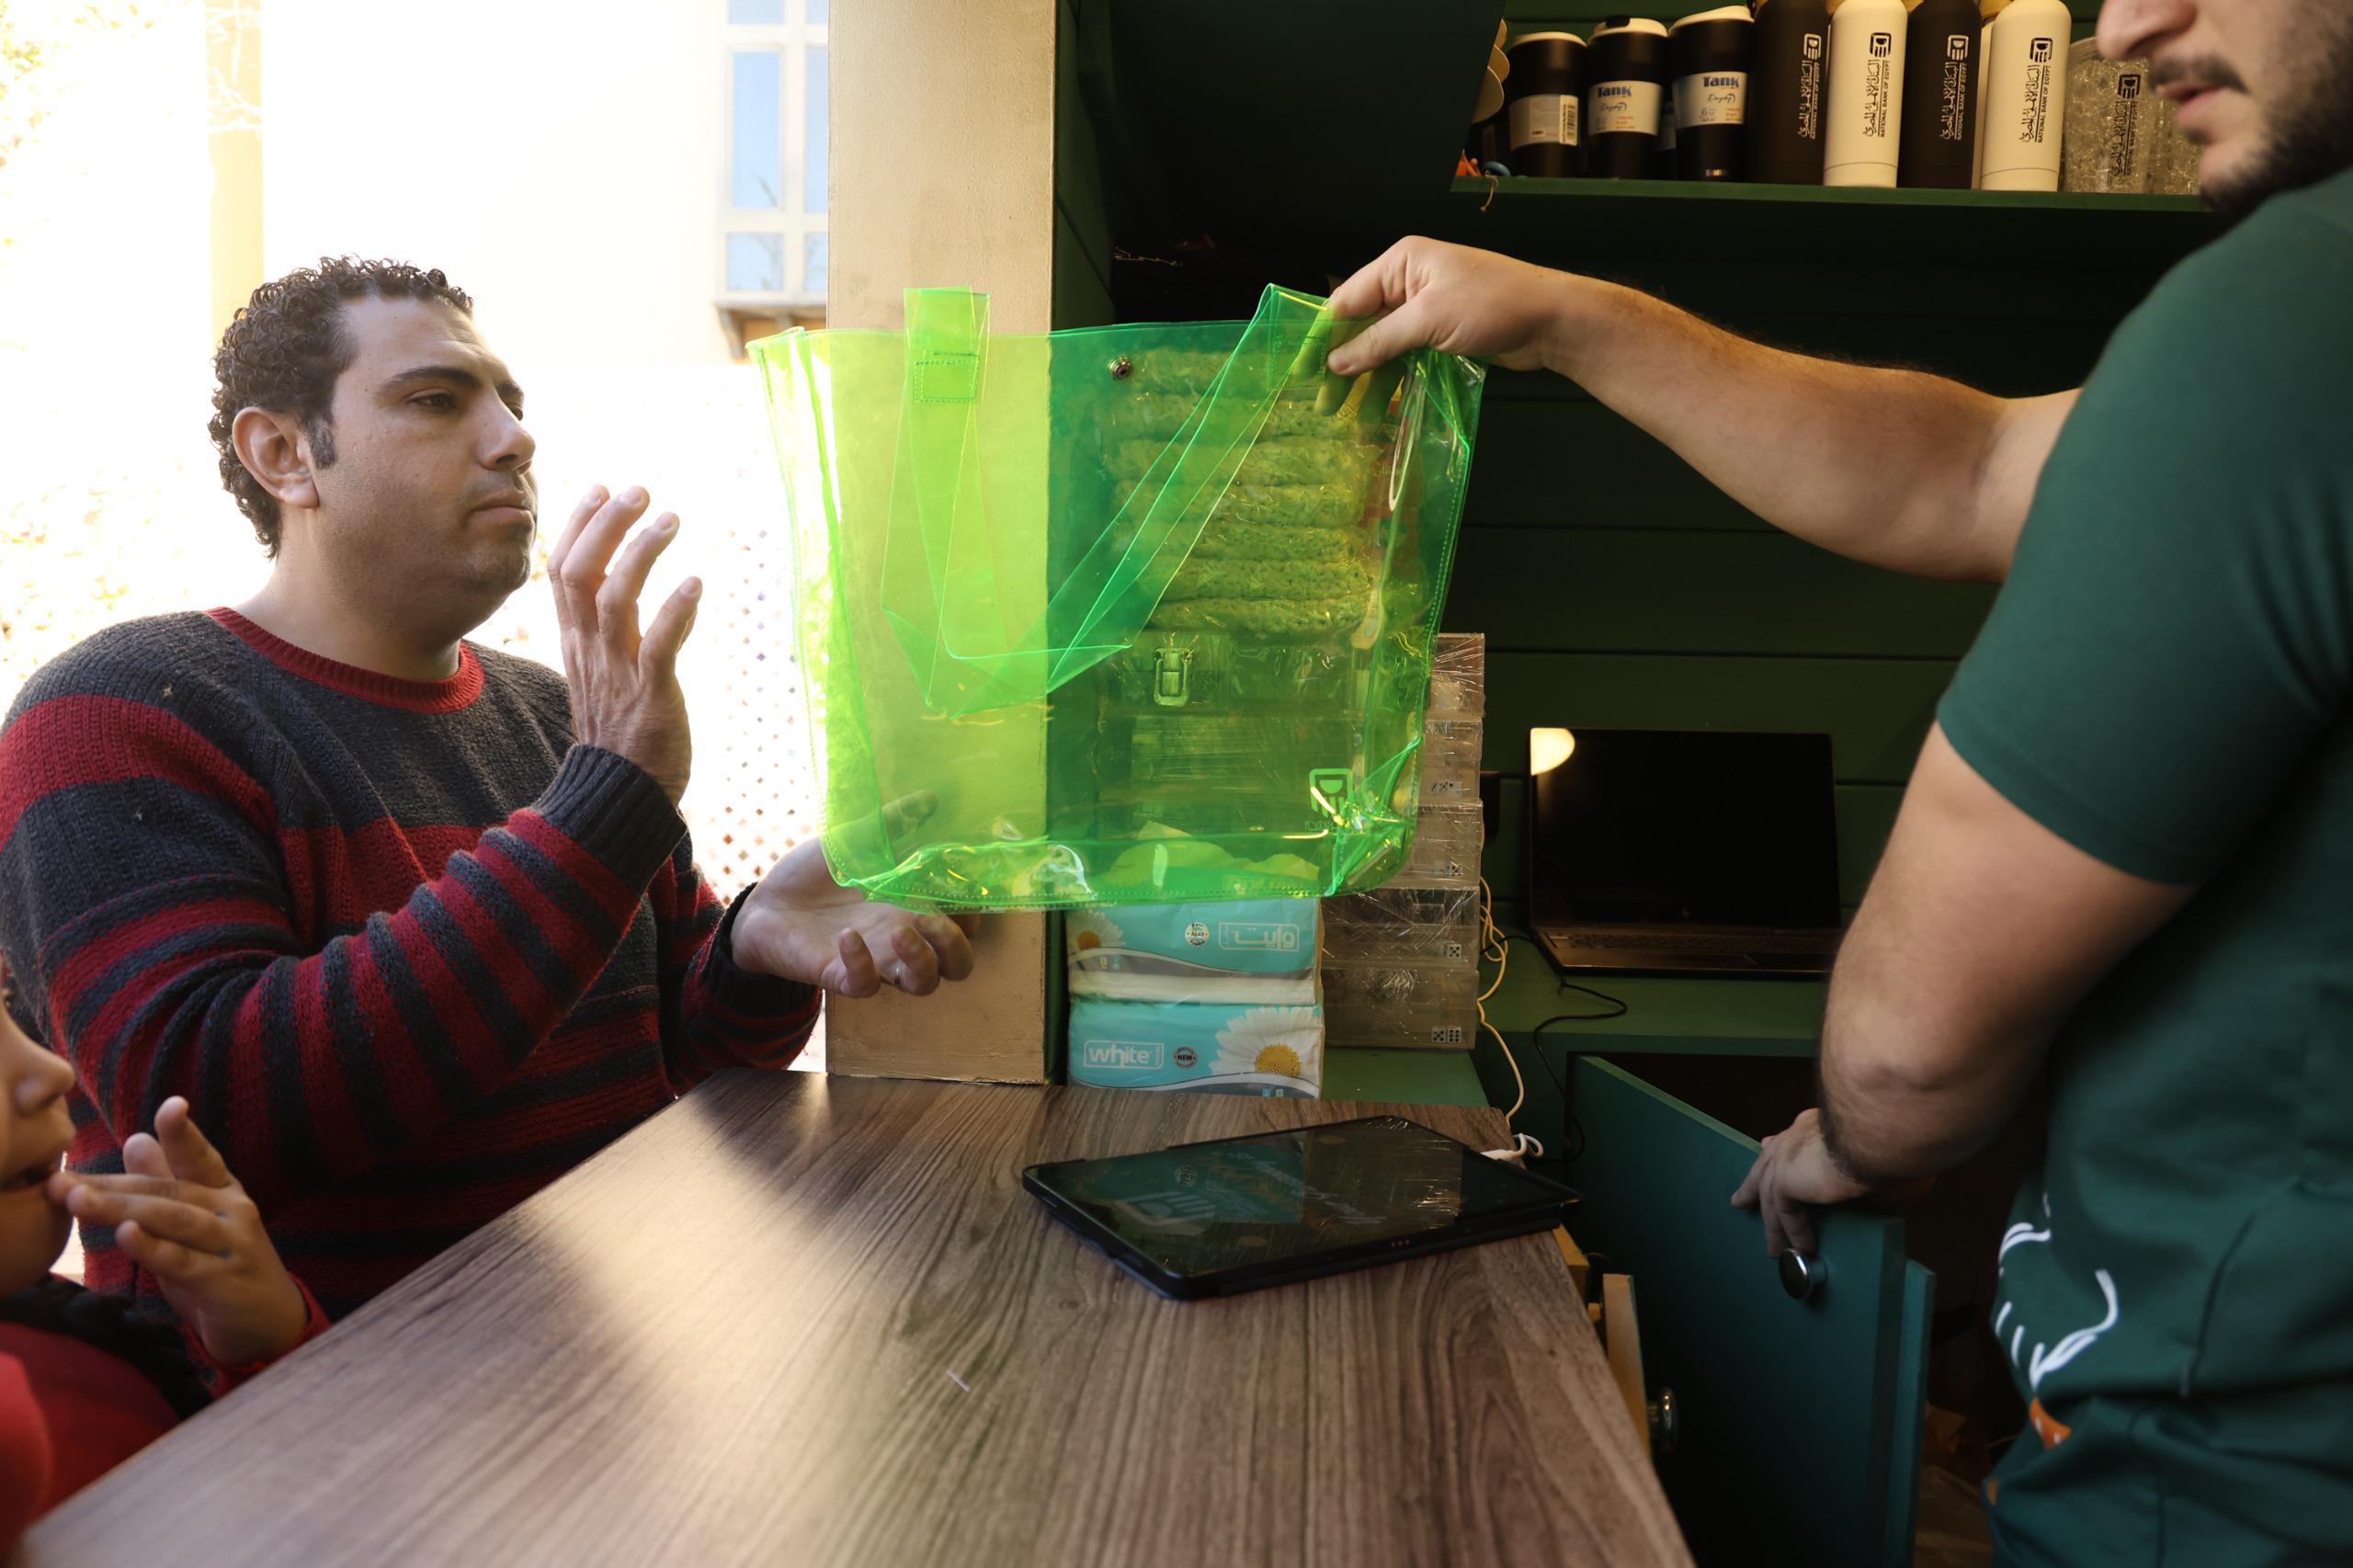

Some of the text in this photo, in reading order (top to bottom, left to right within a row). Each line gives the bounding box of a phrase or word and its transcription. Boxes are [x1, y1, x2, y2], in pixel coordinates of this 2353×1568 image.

[1703, 76, 1739, 87] Tank
[1597, 86, 1632, 97] Tank
[1088, 1043, 1150, 1066] white
